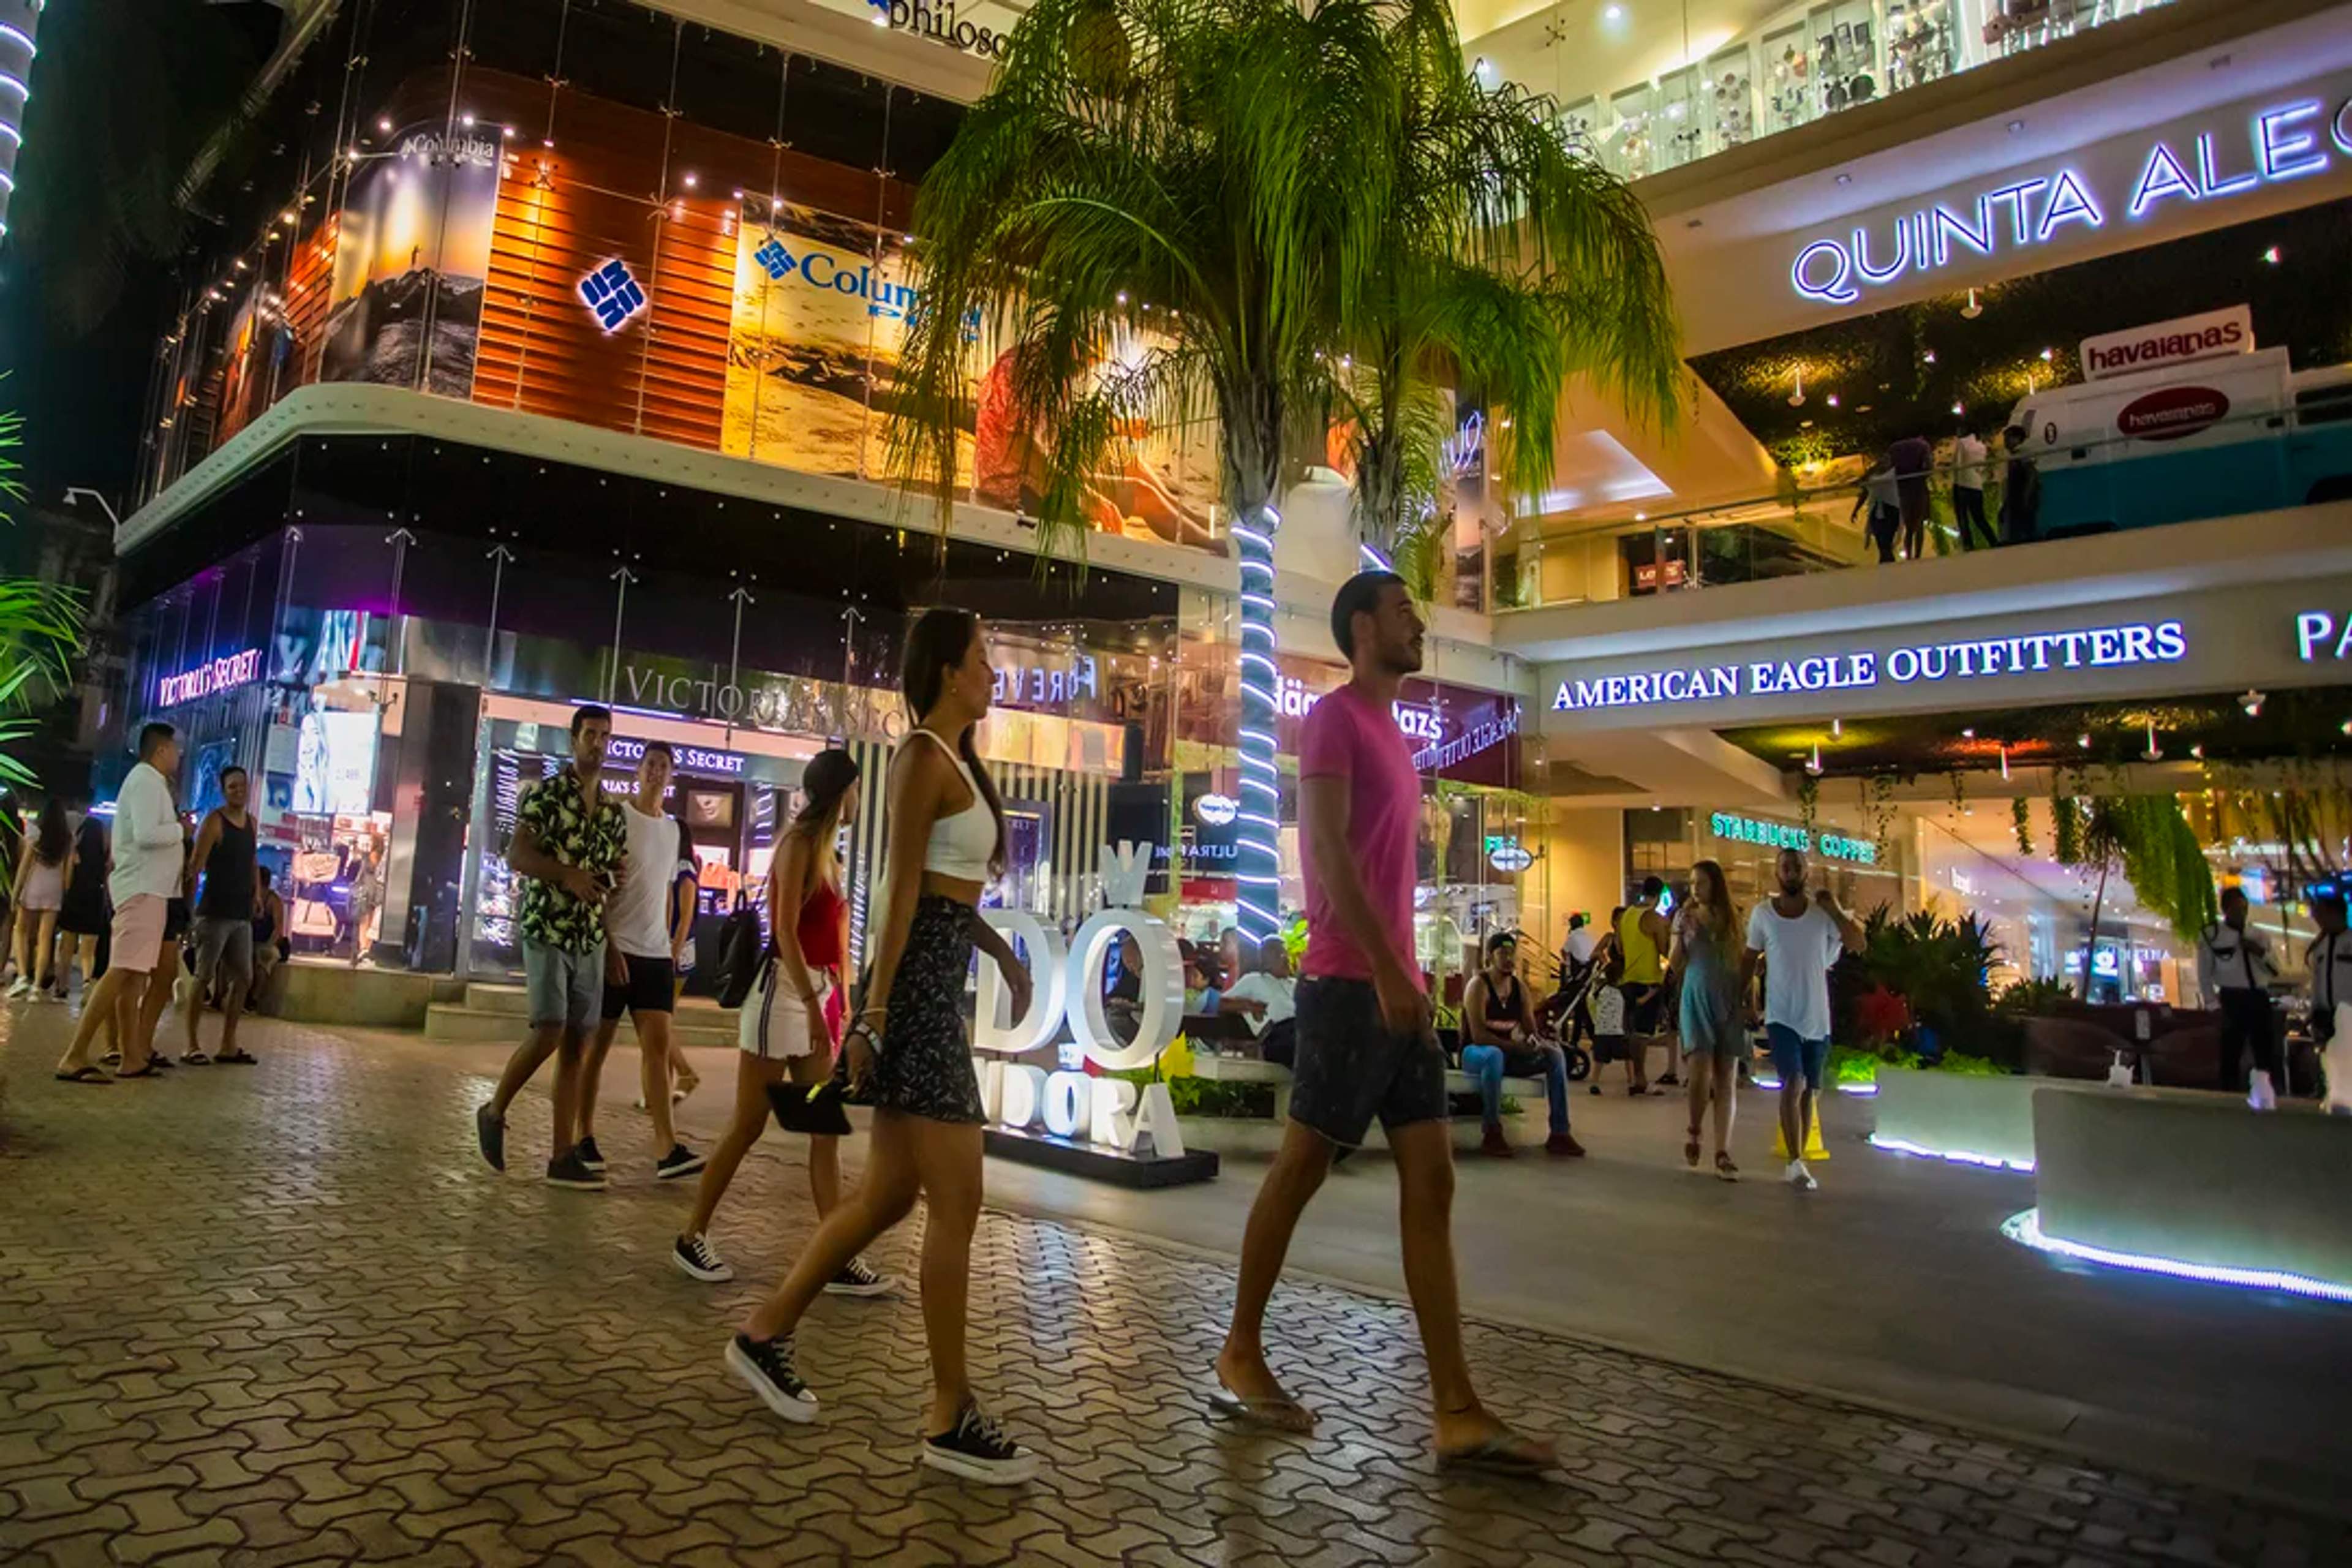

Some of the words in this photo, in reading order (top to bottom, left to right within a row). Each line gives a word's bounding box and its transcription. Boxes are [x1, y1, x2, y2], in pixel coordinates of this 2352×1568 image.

[1792, 168, 2102, 304] QUINTA
[2089, 322, 2242, 371] havaianas
[1551, 665, 1740, 710] AMERICAN
[1750, 653, 1877, 694] EAGLE
[1887, 621, 2187, 681] OUTFITTERS
[687, 749, 744, 772] SECRET
[1711, 812, 1810, 853] STARBUCKS
[1820, 833, 1875, 865] COFFEE
